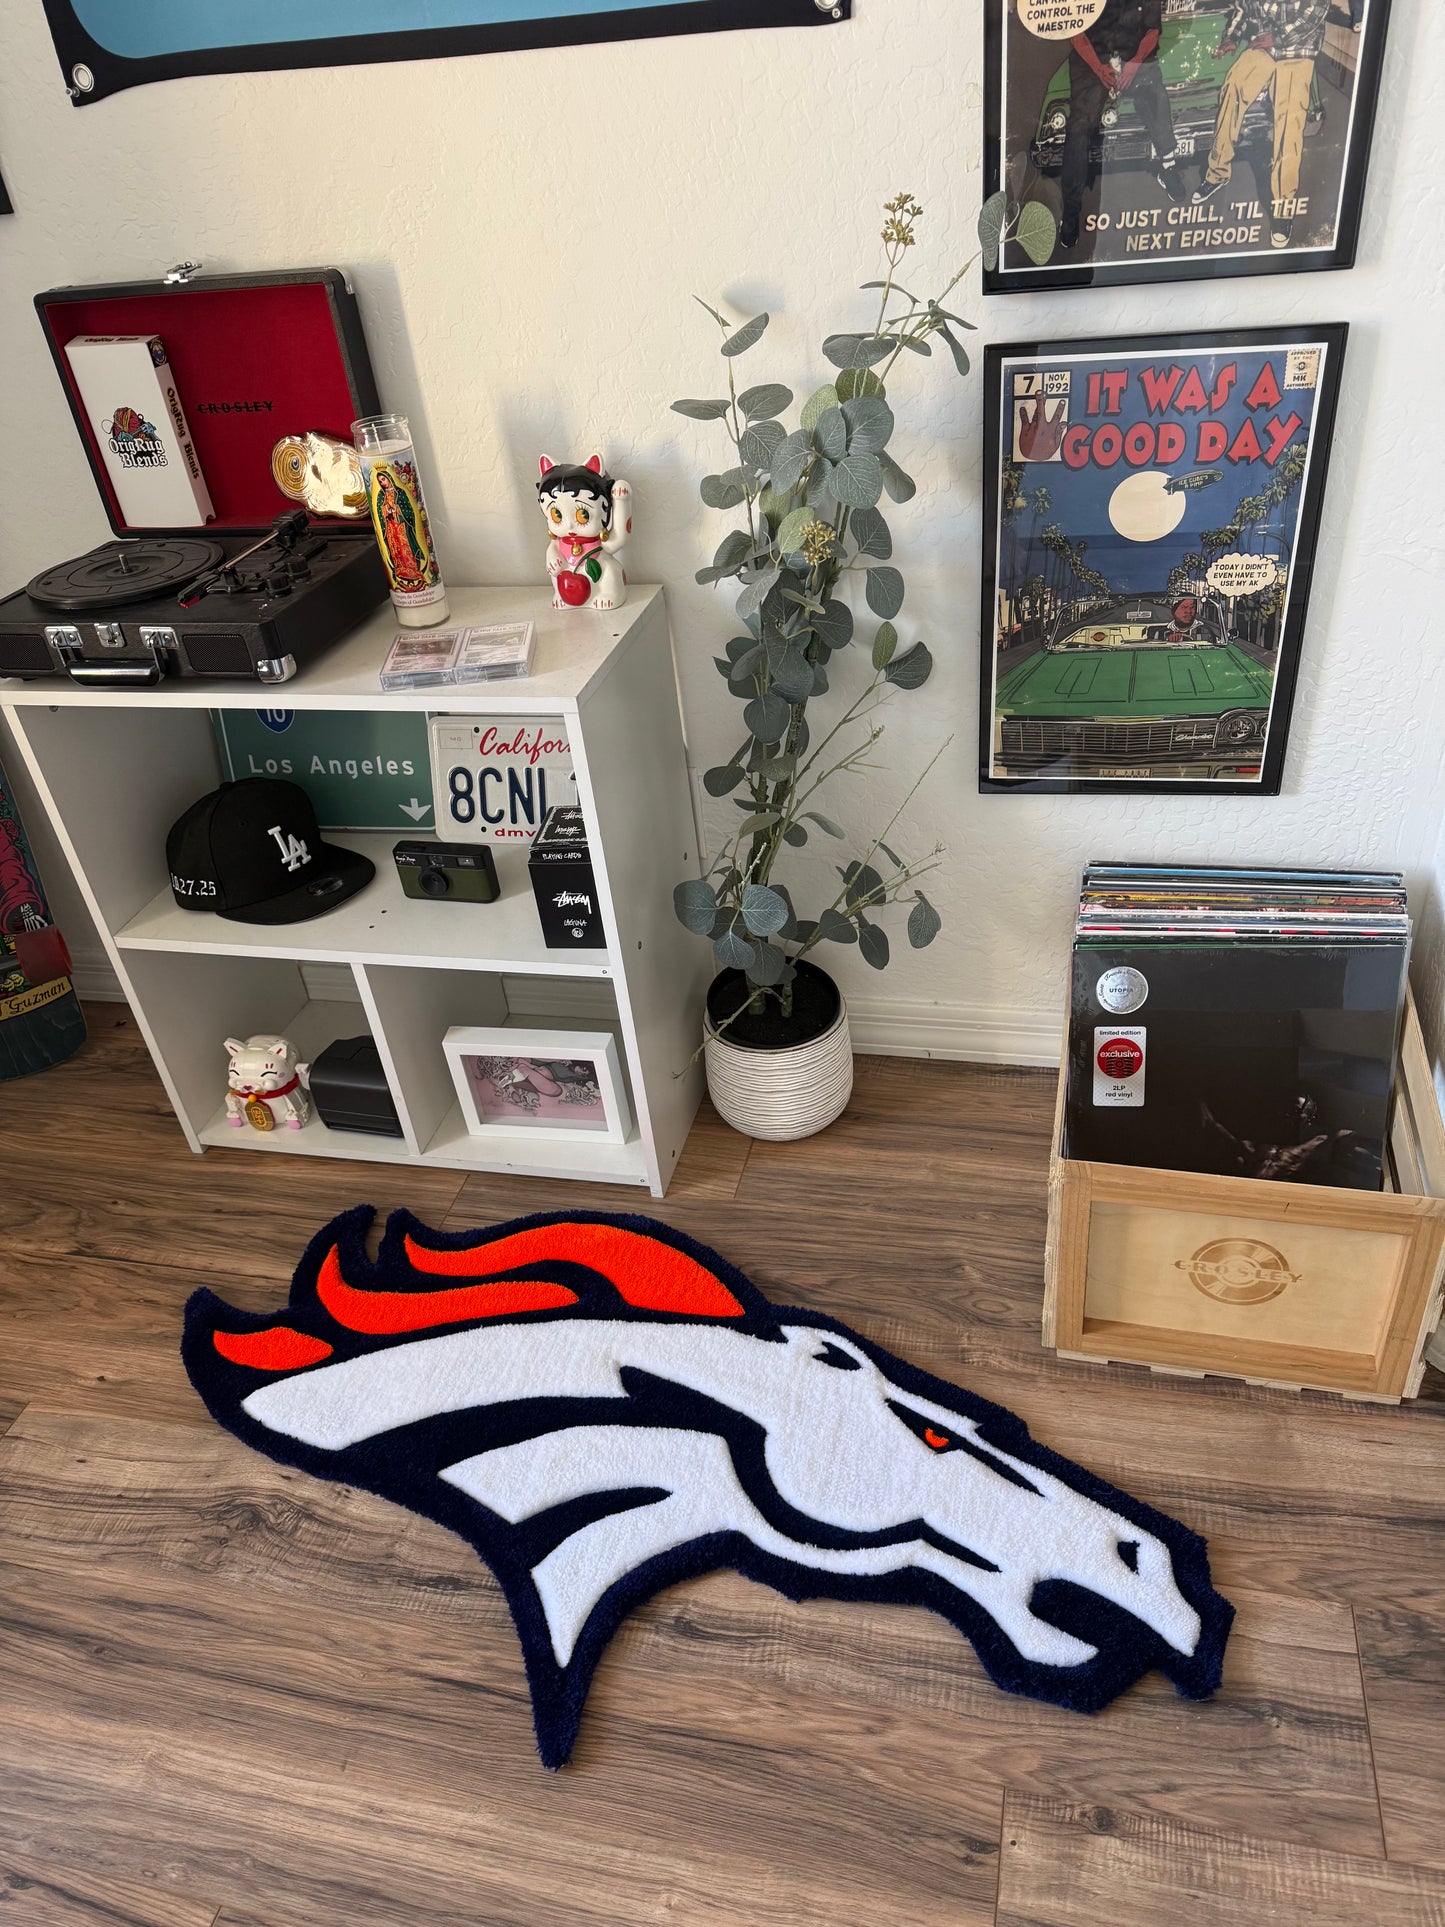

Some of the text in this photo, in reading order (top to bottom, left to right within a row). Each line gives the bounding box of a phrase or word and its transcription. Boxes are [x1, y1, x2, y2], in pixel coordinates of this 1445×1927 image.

[1027, 3, 1095, 20] CONTROL THE
[1037, 19, 1084, 33] MAESTRO
[1085, 197, 1309, 232] SO JUST CHILL, 'TIL THE
[1126, 225, 1261, 252] NEXT EPISODE
[1022, 376, 1035, 393] 7
[1044, 382, 1070, 392] 1992
[1047, 373, 1067, 382] NOV.
[1086, 360, 1283, 417] IT WAS A
[197, 400, 273, 414] CROSLEY
[167, 387, 200, 479] OrigRug Blends
[1062, 410, 1303, 471] GOOD DAY
[108, 438, 165, 455] OrigRug
[120, 451, 168, 468] Blends
[248, 754, 415, 779] Los Angeles
[267, 825, 312, 872] LA
[4, 982, 65, 1014] Guzman
[1100, 1050, 1140, 1058] exclusive
[1172, 1260, 1303, 1283] CROSLEY
